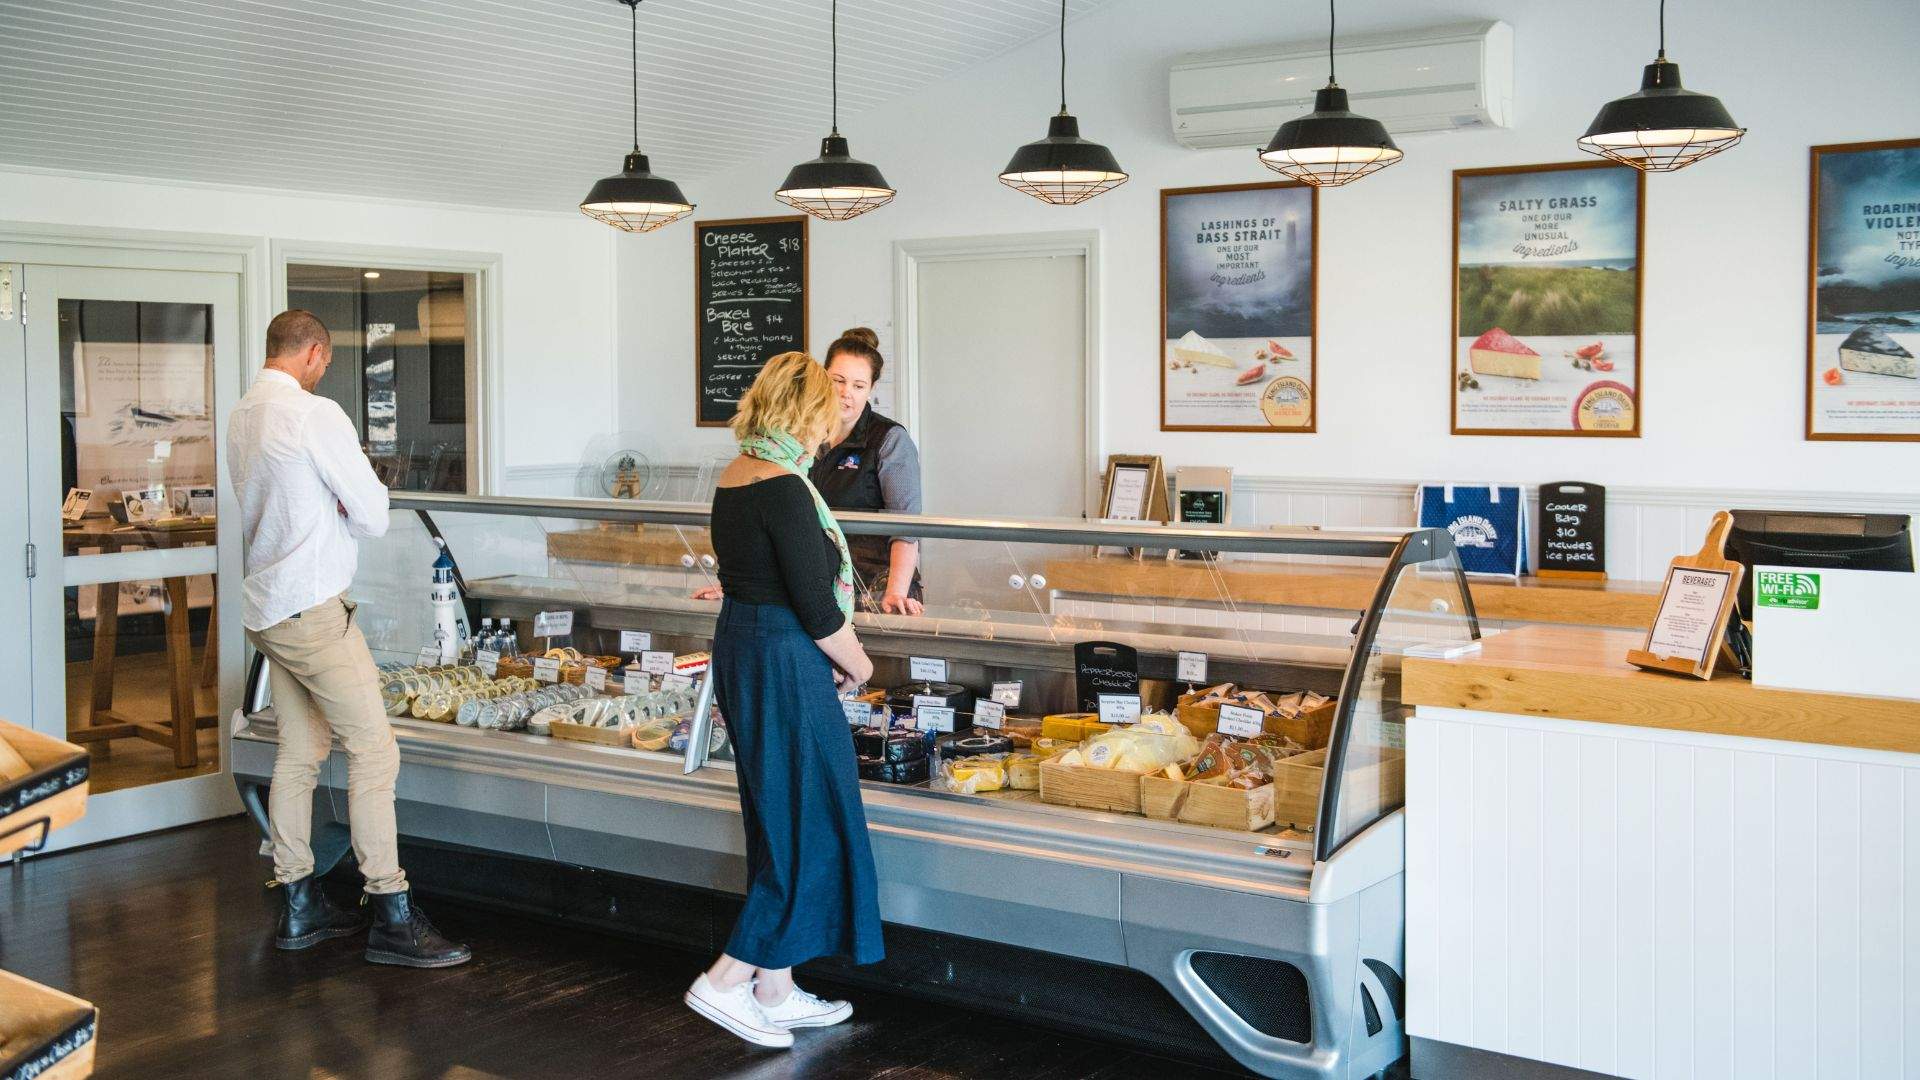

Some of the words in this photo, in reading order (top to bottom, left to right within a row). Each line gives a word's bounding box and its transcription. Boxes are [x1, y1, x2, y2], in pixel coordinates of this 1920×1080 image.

[1499, 199, 1543, 212] SALTY
[1548, 196, 1597, 209] GRASS
[1521, 214, 1538, 222] ONE
[1541, 213, 1552, 221] OF
[1553, 212, 1572, 220] OUR
[1201, 219, 1258, 231] LASHINGS
[1262, 217, 1276, 227] OF
[1534, 222, 1559, 230] MORE
[1196, 231, 1229, 244] BASS
[1234, 229, 1281, 242] STRAIT
[1524, 231, 1569, 241] UNUSUAL
[778, 237, 800, 253] $18
[1216, 245, 1231, 253] ONE
[1243, 244, 1259, 252] OUR
[1512, 239, 1579, 260] ingredients
[1225, 252, 1250, 261] MOST
[1216, 262, 1259, 270] IMPORTANT
[1208, 269, 1266, 288] ingredients
[765, 314, 783, 325] $14
[1457, 514, 1484, 526] ISLAND
[1555, 513, 1580, 526] Bag
[1556, 527, 1577, 538] $10
[1547, 538, 1593, 550] includes
[1545, 550, 1563, 560] ice
[1566, 552, 1596, 562] pack
[1682, 574, 1718, 587] BEVERAGES
[1760, 572, 1794, 584] FREE
[1760, 583, 1794, 595] WI-FI
